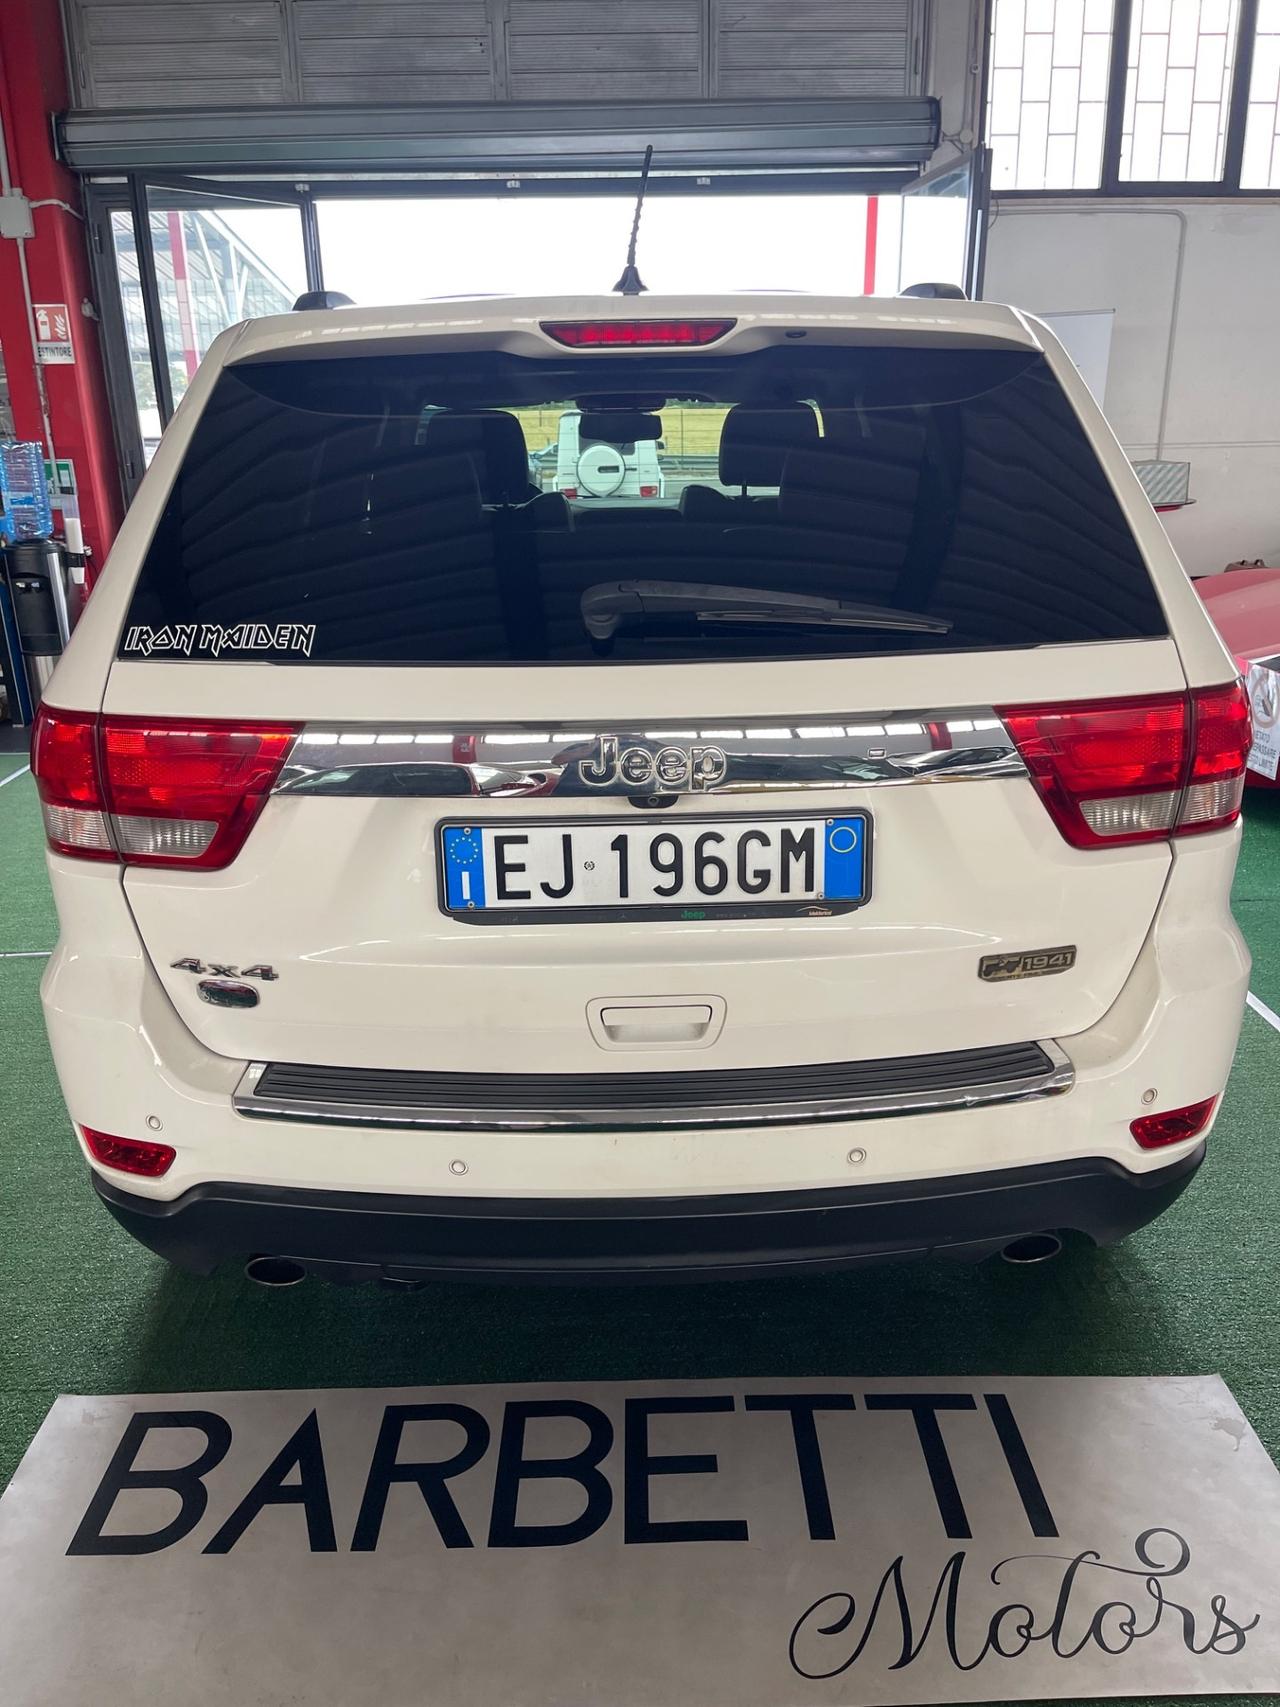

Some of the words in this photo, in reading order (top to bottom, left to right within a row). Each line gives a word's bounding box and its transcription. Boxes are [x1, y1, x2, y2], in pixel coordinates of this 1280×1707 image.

[37, 346, 72, 358] ESTINTORE
[124, 625, 198, 656] IRON
[199, 624, 317, 657] MAIDEN
[578, 736, 727, 792] Jeep
[494, 833, 575, 900] EJ
[610, 827, 816, 898] 196GM
[681, 910, 706, 920] Jeep
[1024, 952, 1073, 970] 1941
[65, 1393, 1060, 1556] BARBETTI
[789, 1528, 1260, 1681] Motors
